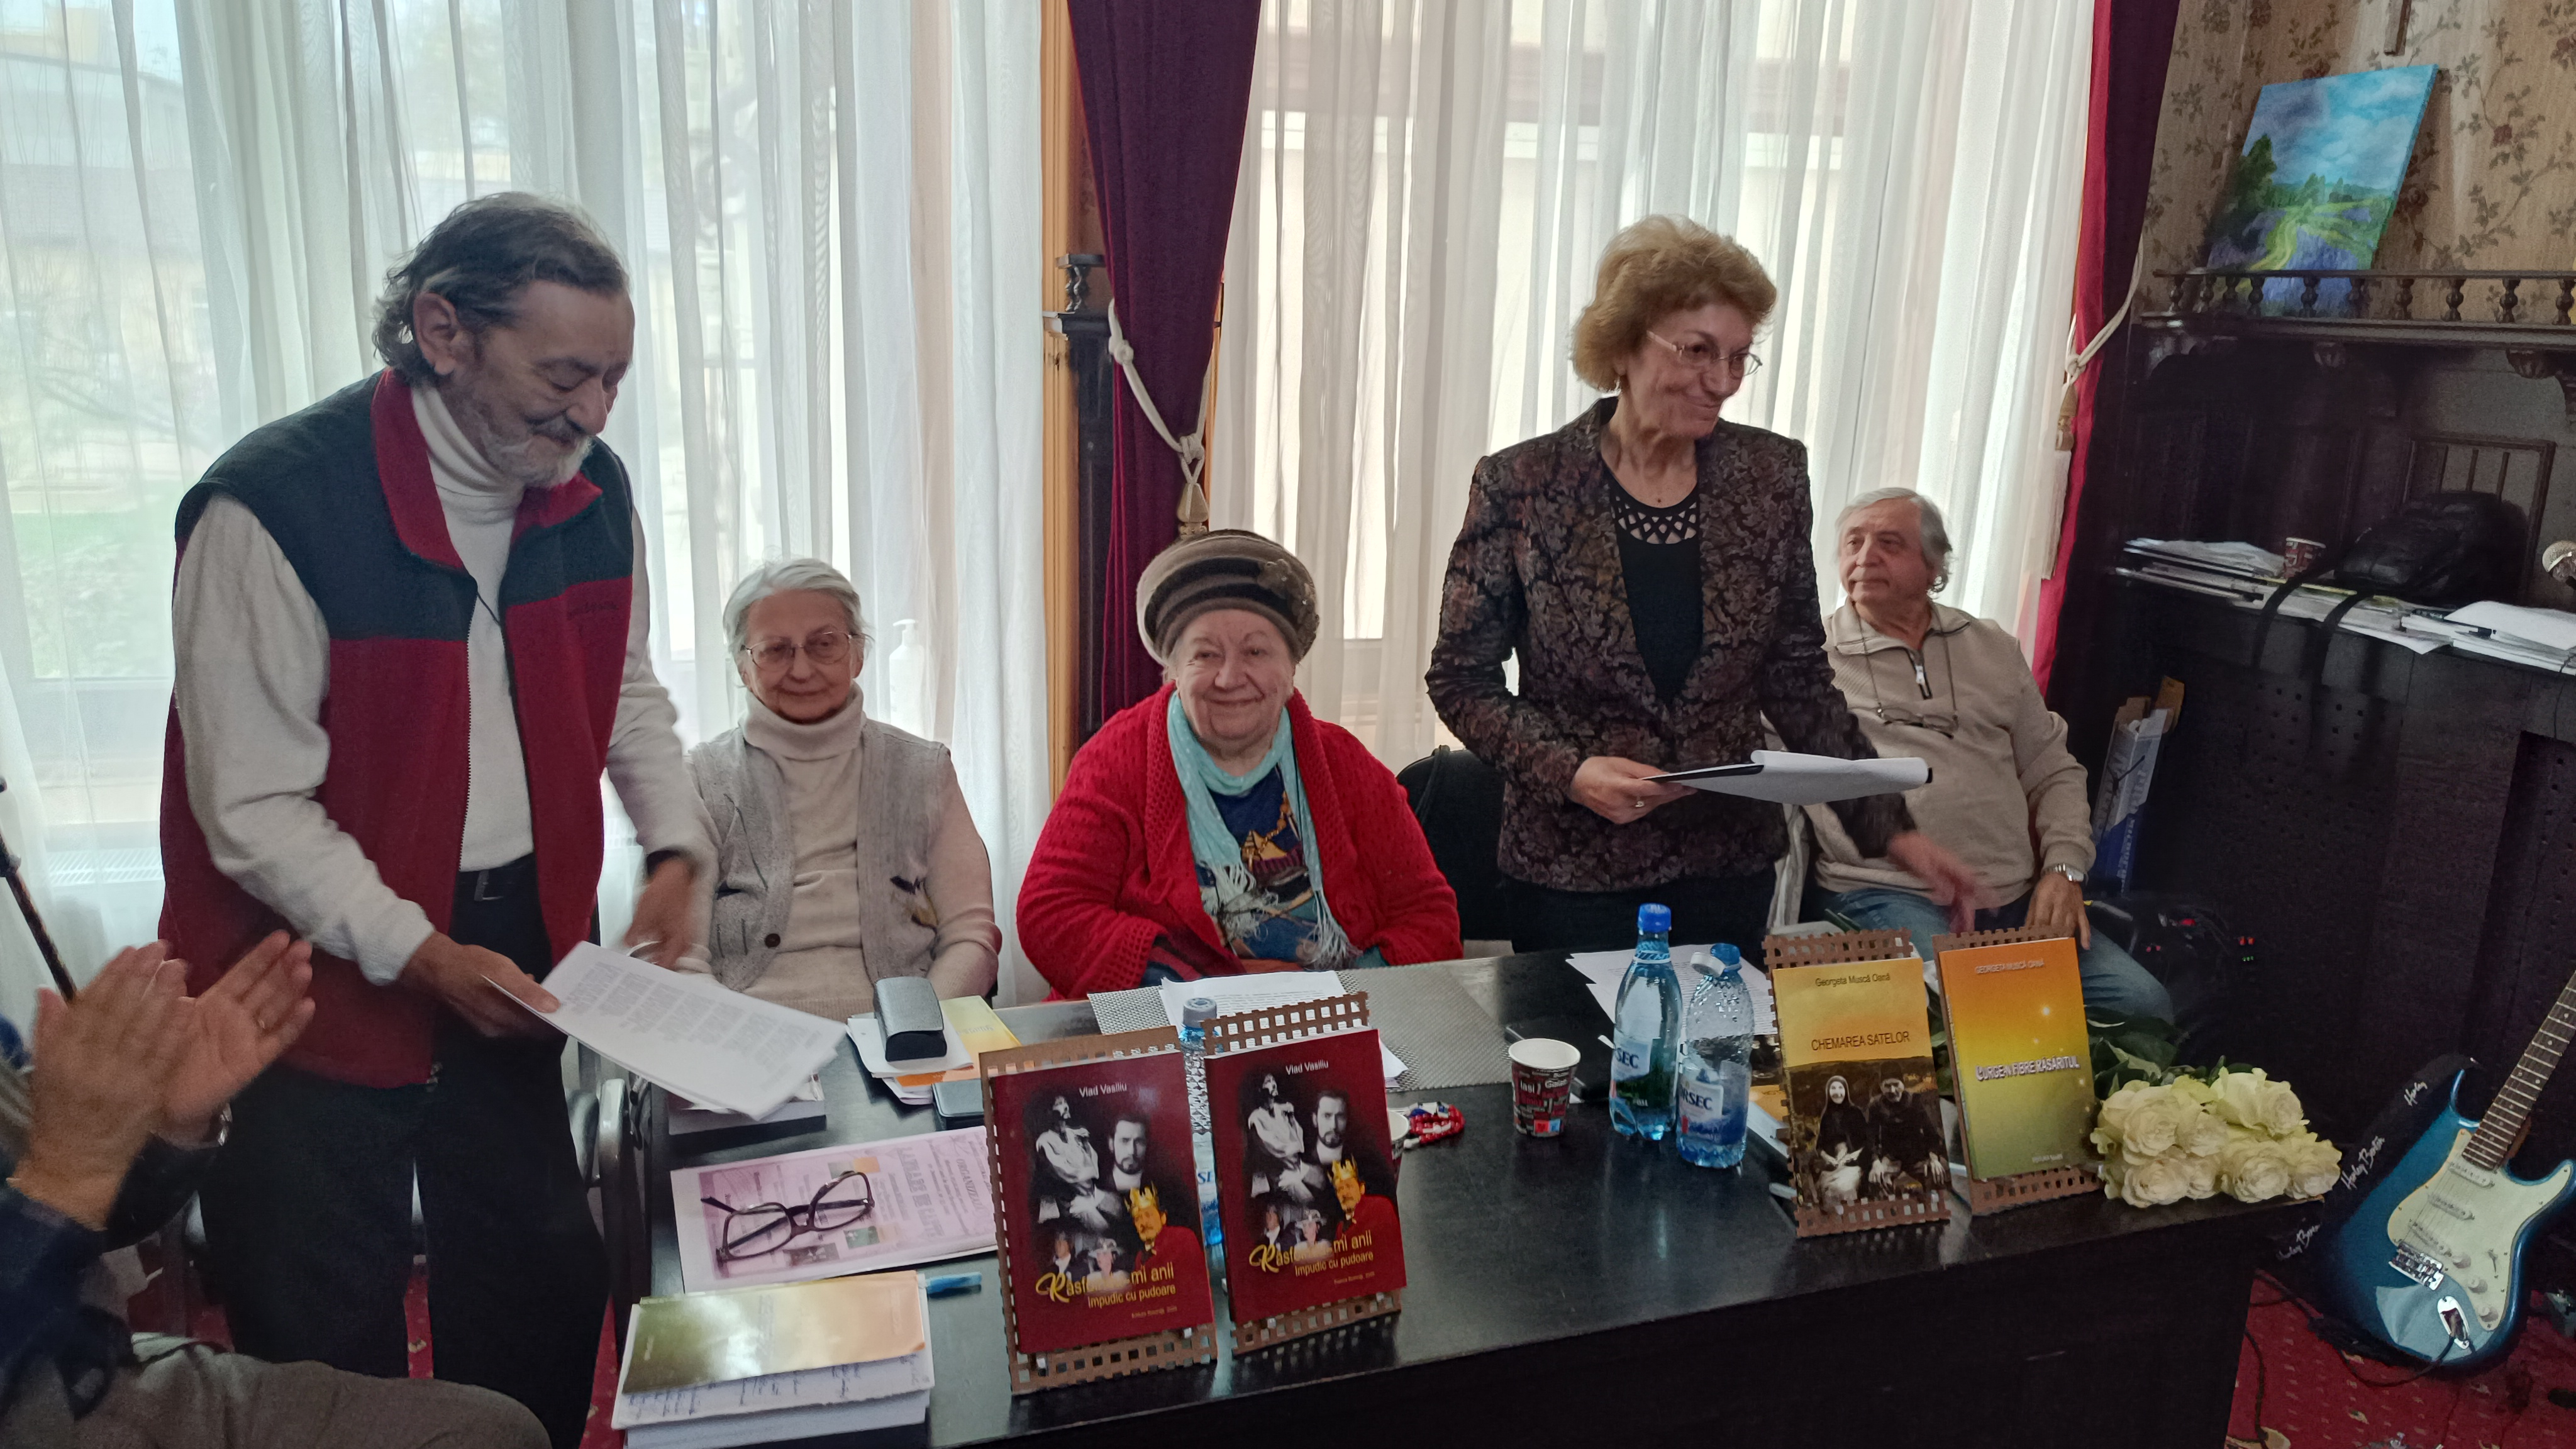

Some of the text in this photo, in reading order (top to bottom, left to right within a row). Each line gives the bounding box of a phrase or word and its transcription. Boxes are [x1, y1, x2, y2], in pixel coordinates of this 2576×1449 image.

[1815, 977, 1847, 987] Georgeta
[1811, 1031, 1911, 1051] CHEMAREA SATELOR
[1285, 1059, 1329, 1076] Vlad Vasiliu
[1079, 1081, 1128, 1097] Vlad Vasiliu
[1328, 1258, 1339, 1269] cu
[1340, 1250, 1374, 1269] pudoare
[1125, 1292, 1137, 1302] cu
[1139, 1284, 1177, 1302] pudoare
